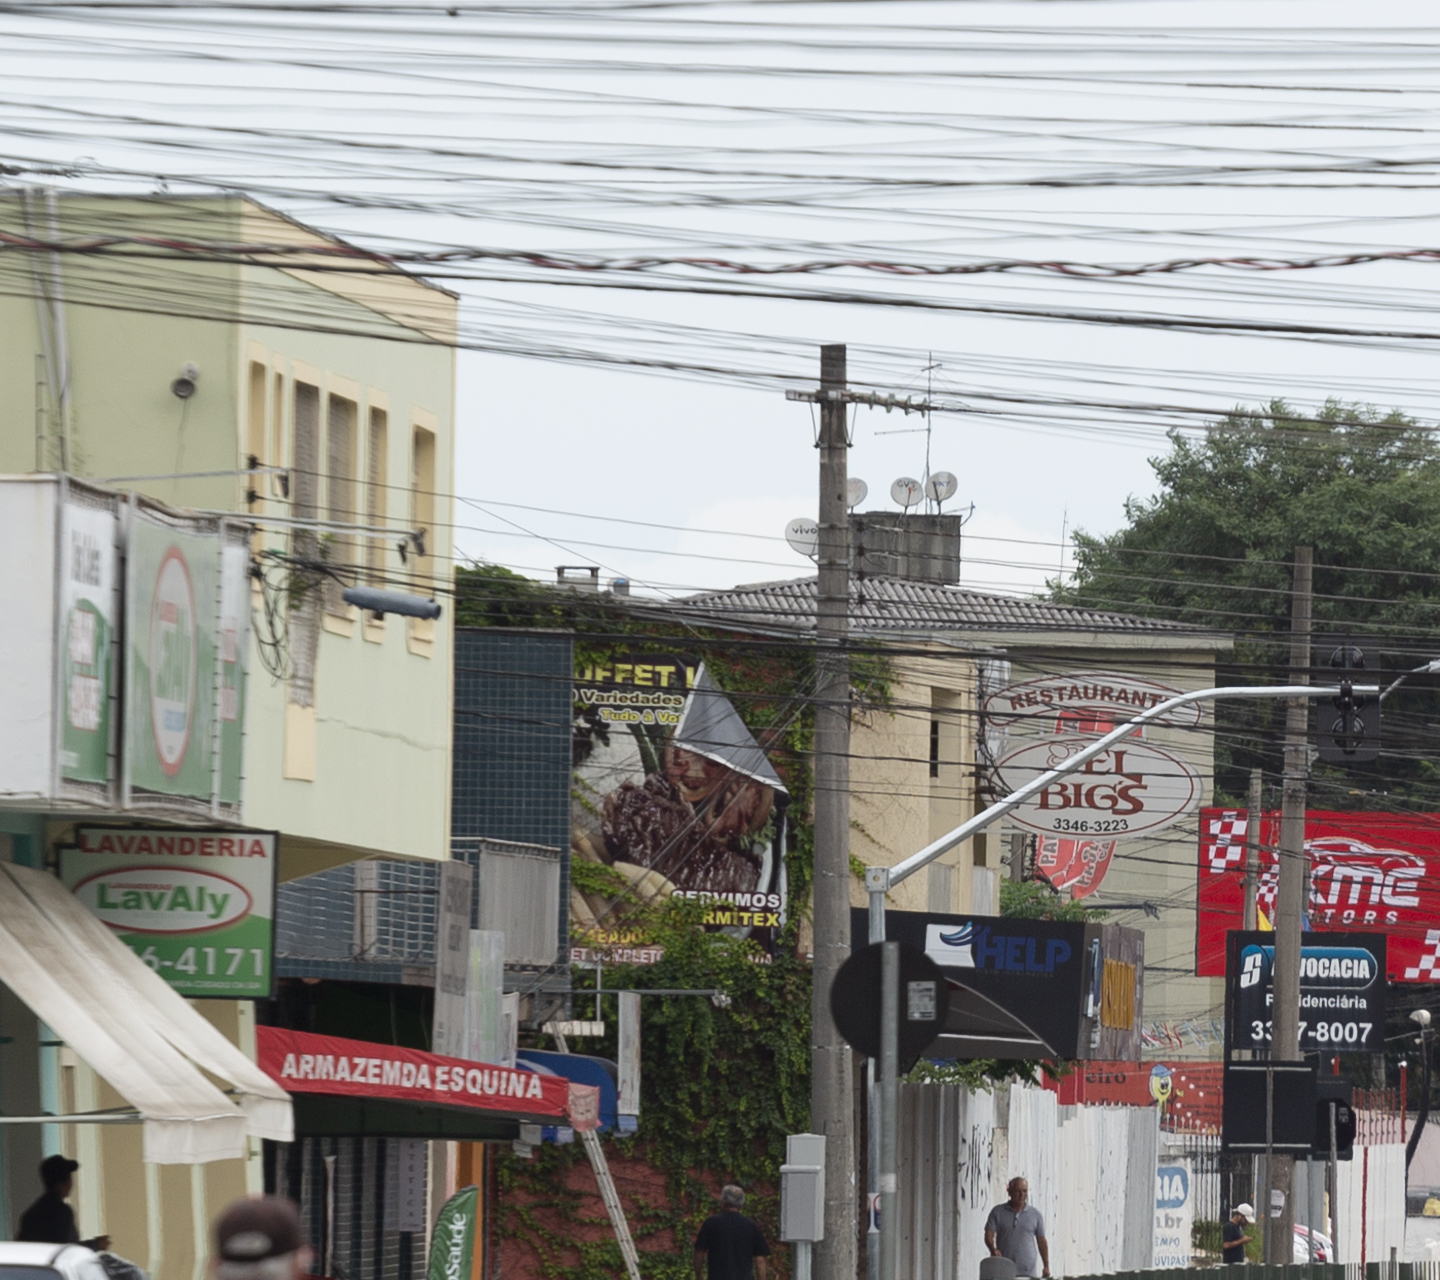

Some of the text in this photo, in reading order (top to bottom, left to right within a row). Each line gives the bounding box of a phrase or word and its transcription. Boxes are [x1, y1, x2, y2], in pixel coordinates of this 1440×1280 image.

[792, 525, 817, 535] vivo
[582, 689, 684, 707] Variedades
[600, 709, 639, 721] Tudo
[1053, 817, 1129, 833] 3346-3223
[79, 834, 268, 858] LAVANDERIA
[96, 882, 231, 919] LavAly
[976, 926, 1073, 972] HELP
[127, 945, 265, 976] 6-4171
[435, 1066, 543, 1099] ESQUINA
[1085, 1068, 1127, 1084] eiro
